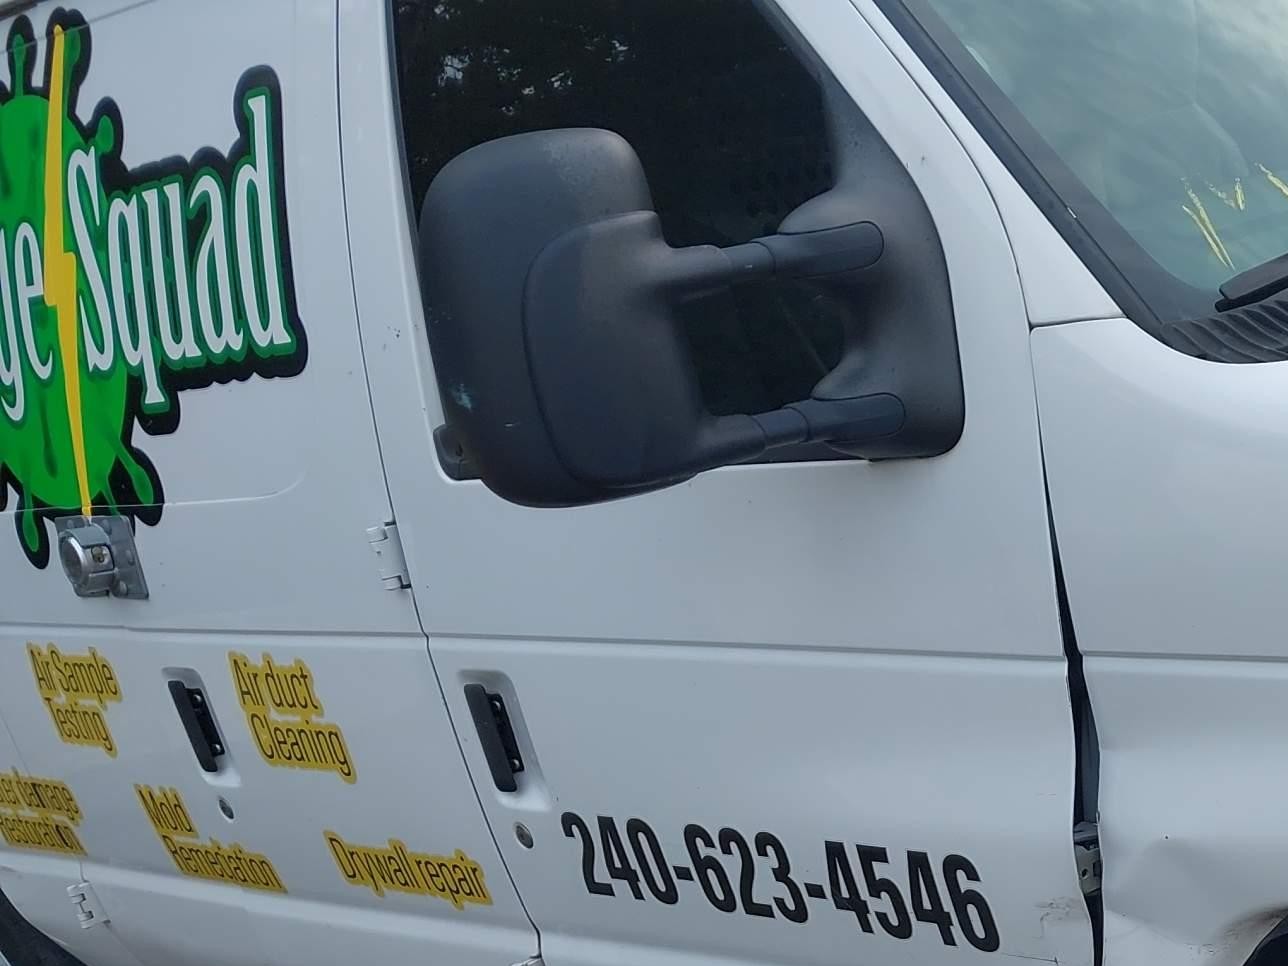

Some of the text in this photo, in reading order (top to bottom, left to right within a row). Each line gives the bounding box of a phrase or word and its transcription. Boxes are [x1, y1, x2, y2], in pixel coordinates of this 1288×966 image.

[67, 94, 292, 405] Squad
[30, 648, 118, 705] Air Sample
[232, 658, 319, 710] Air duct
[44, 697, 113, 752] Testing
[250, 713, 352, 777] Cleaning
[138, 788, 195, 833] Mold
[328, 837, 488, 904] Drywall repair
[560, 811, 1001, 953] 240-623-4546
